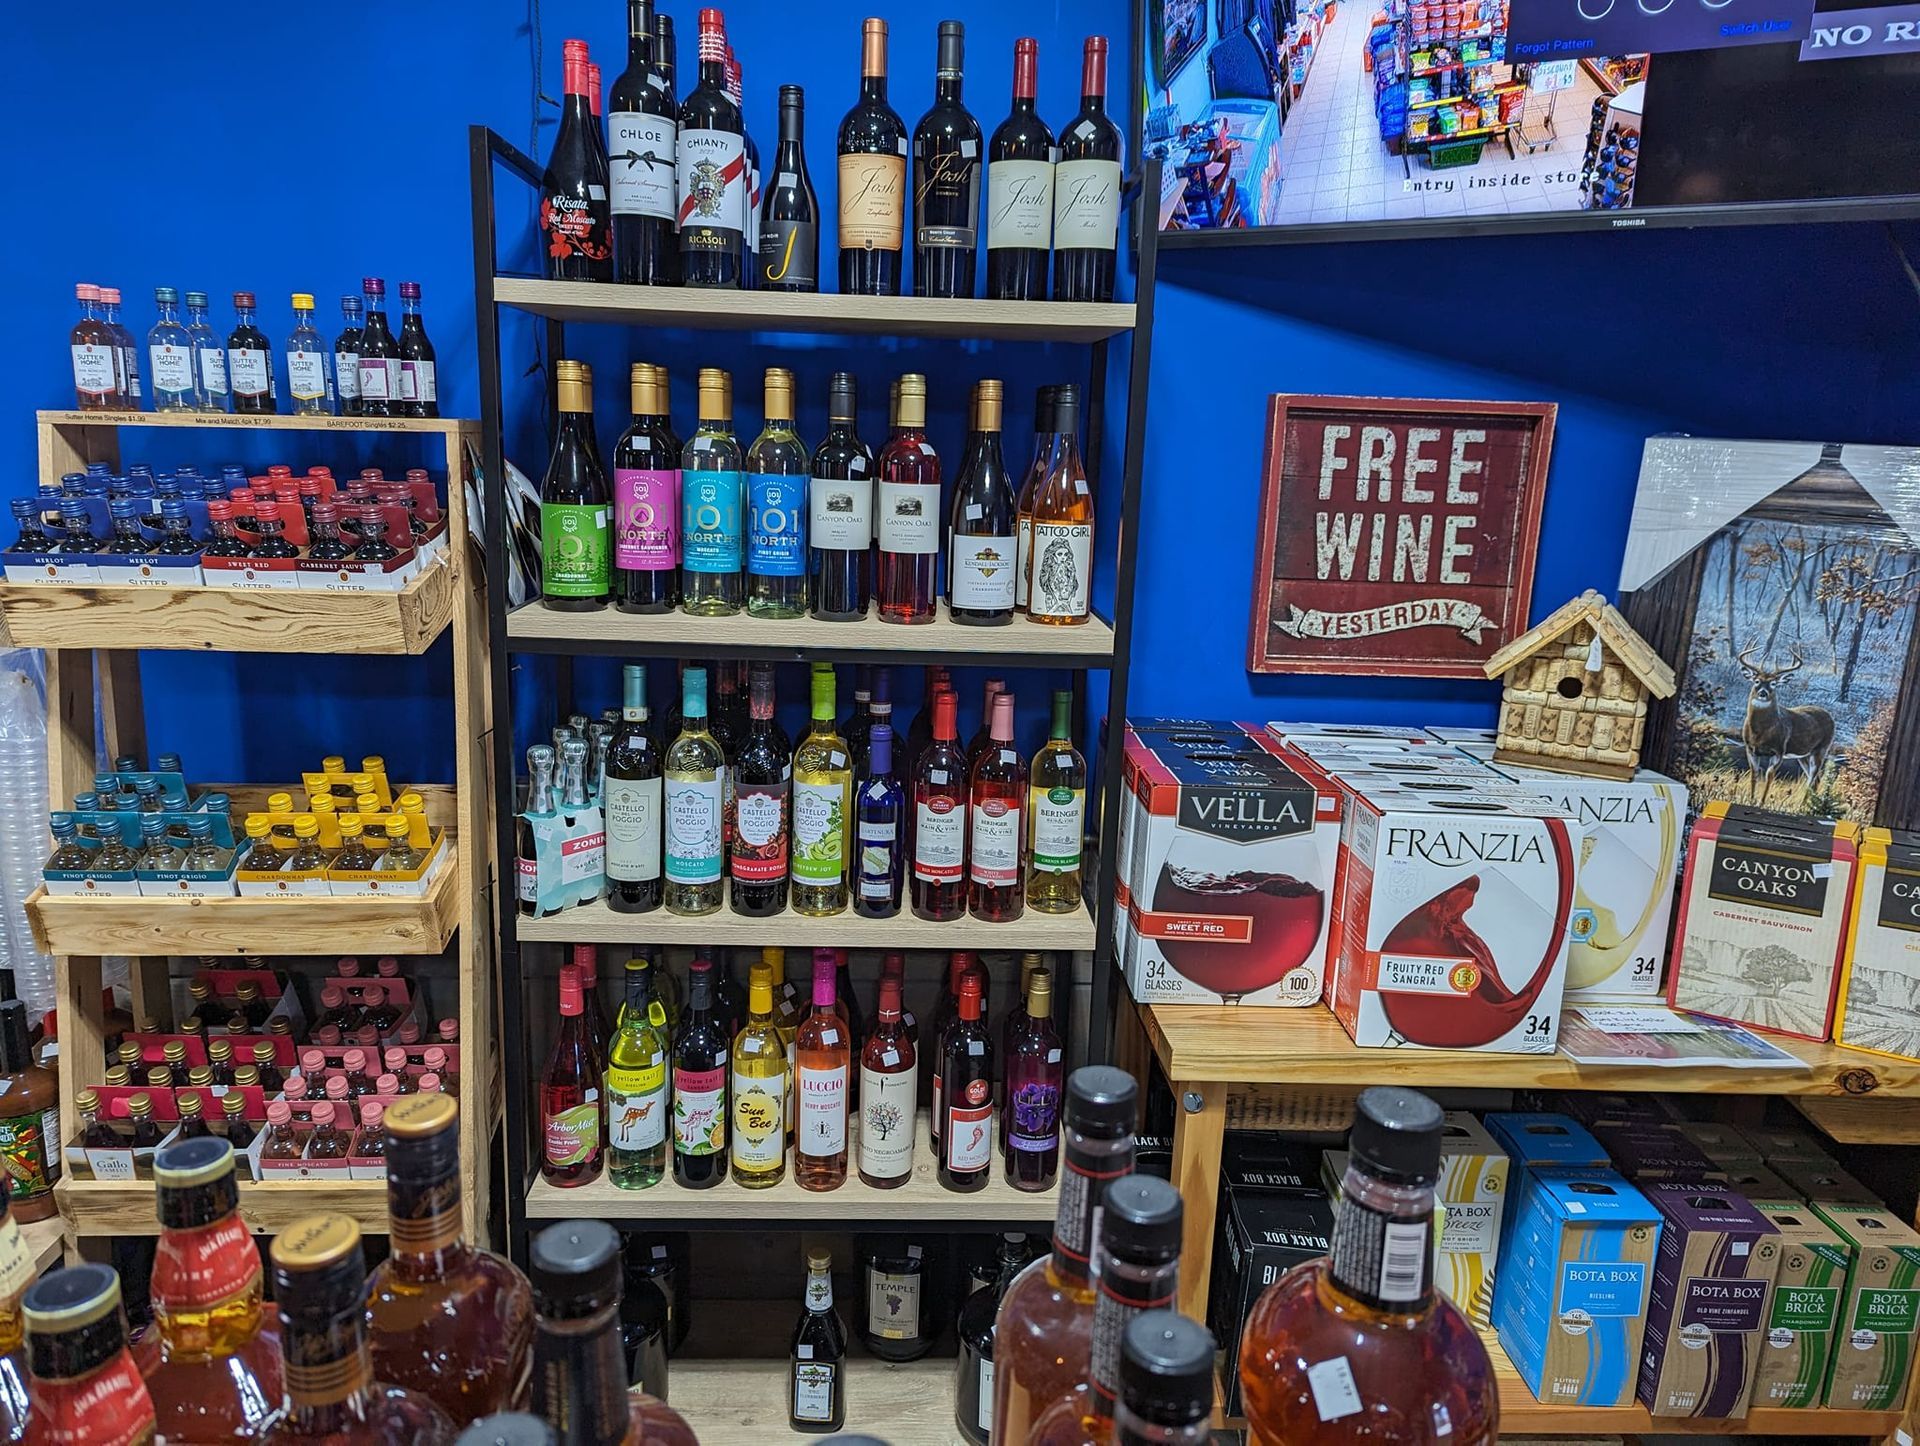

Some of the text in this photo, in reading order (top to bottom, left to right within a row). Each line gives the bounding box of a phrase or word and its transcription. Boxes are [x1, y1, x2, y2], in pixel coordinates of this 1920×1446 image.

[1720, 19, 1792, 35] Switch User
[1811, 21, 1920, 48] NO R
[1515, 38, 1594, 55] Forgot Pattern
[620, 129, 662, 142] CHLOE
[687, 138, 728, 150] CHIANTI
[916, 151, 971, 205] Josh
[1403, 171, 1600, 193] Entry inside store
[844, 165, 897, 214] Josh
[991, 175, 1047, 228] Josh
[1056, 175, 1109, 229] Josh
[562, 214, 596, 224] Moscato
[1612, 219, 1646, 227] TOSHIBA
[689, 236, 726, 244] RICASOLI
[365, 421, 387, 429] Singles
[1319, 425, 1486, 504] FREE
[817, 514, 844, 523] CANYON
[886, 518, 913, 527] CANYON
[619, 530, 667, 540] NORTH
[686, 532, 733, 543] NORTH
[1036, 526, 1069, 537] TATTOO
[1071, 527, 1090, 537] GIRL
[752, 536, 799, 546] NORTH
[1316, 512, 1476, 584] WINE
[550, 562, 595, 571] NORTH
[1320, 603, 1460, 635] YESTERDAY
[610, 804, 645, 812] CASTELLO
[673, 806, 708, 814] CASTELLO
[1040, 809, 1080, 817] BERINGER
[675, 818, 706, 826] POGGIO
[1386, 827, 1546, 867] FRANZIA
[1721, 857, 1817, 884] CANYON
[1737, 876, 1797, 898] OAKS
[1166, 923, 1200, 931] SWEET
[1574, 920, 1592, 931] 150
[1713, 910, 1813, 933] CABERNET SAUVIGNON
[1146, 960, 1166, 978] 34
[1387, 961, 1444, 975] FRUITY RED
[1633, 957, 1656, 975] 34
[1391, 973, 1437, 986] SANGRIA
[1457, 971, 1475, 983] 150
[1145, 980, 1182, 991] GLASSES
[1290, 978, 1308, 991] 100
[1525, 1015, 1551, 1035] 34
[803, 1078, 843, 1092] LUCCIO
[739, 1103, 765, 1116] Sun
[805, 1102, 819, 1110] BERRY
[548, 1118, 595, 1132] Arbor Mist
[749, 1117, 772, 1128] Bee
[96, 1160, 128, 1170] Gallo
[1242, 1173, 1301, 1185] BLACK BOX
[1659, 1183, 1728, 1192] BOTA BOX
[1466, 1207, 1492, 1217] BOX
[1264, 1231, 1328, 1248] BLACK BOX
[1570, 1270, 1638, 1282] BOTA BOX
[875, 1283, 916, 1294] TEMPLE
[1692, 1286, 1761, 1299] BOTA BOX
[1589, 1292, 1615, 1300] RIESLING
[1789, 1292, 1824, 1303] BOTA
[1872, 1293, 1908, 1304] BOTA
[1697, 1307, 1708, 1315] OLD
[1722, 1308, 1749, 1316] ZINFANDEL
[1785, 1302, 1827, 1314] BRICK
[1868, 1304, 1909, 1315] BRICK
[797, 1374, 834, 1382] MANISCHEWITZ
